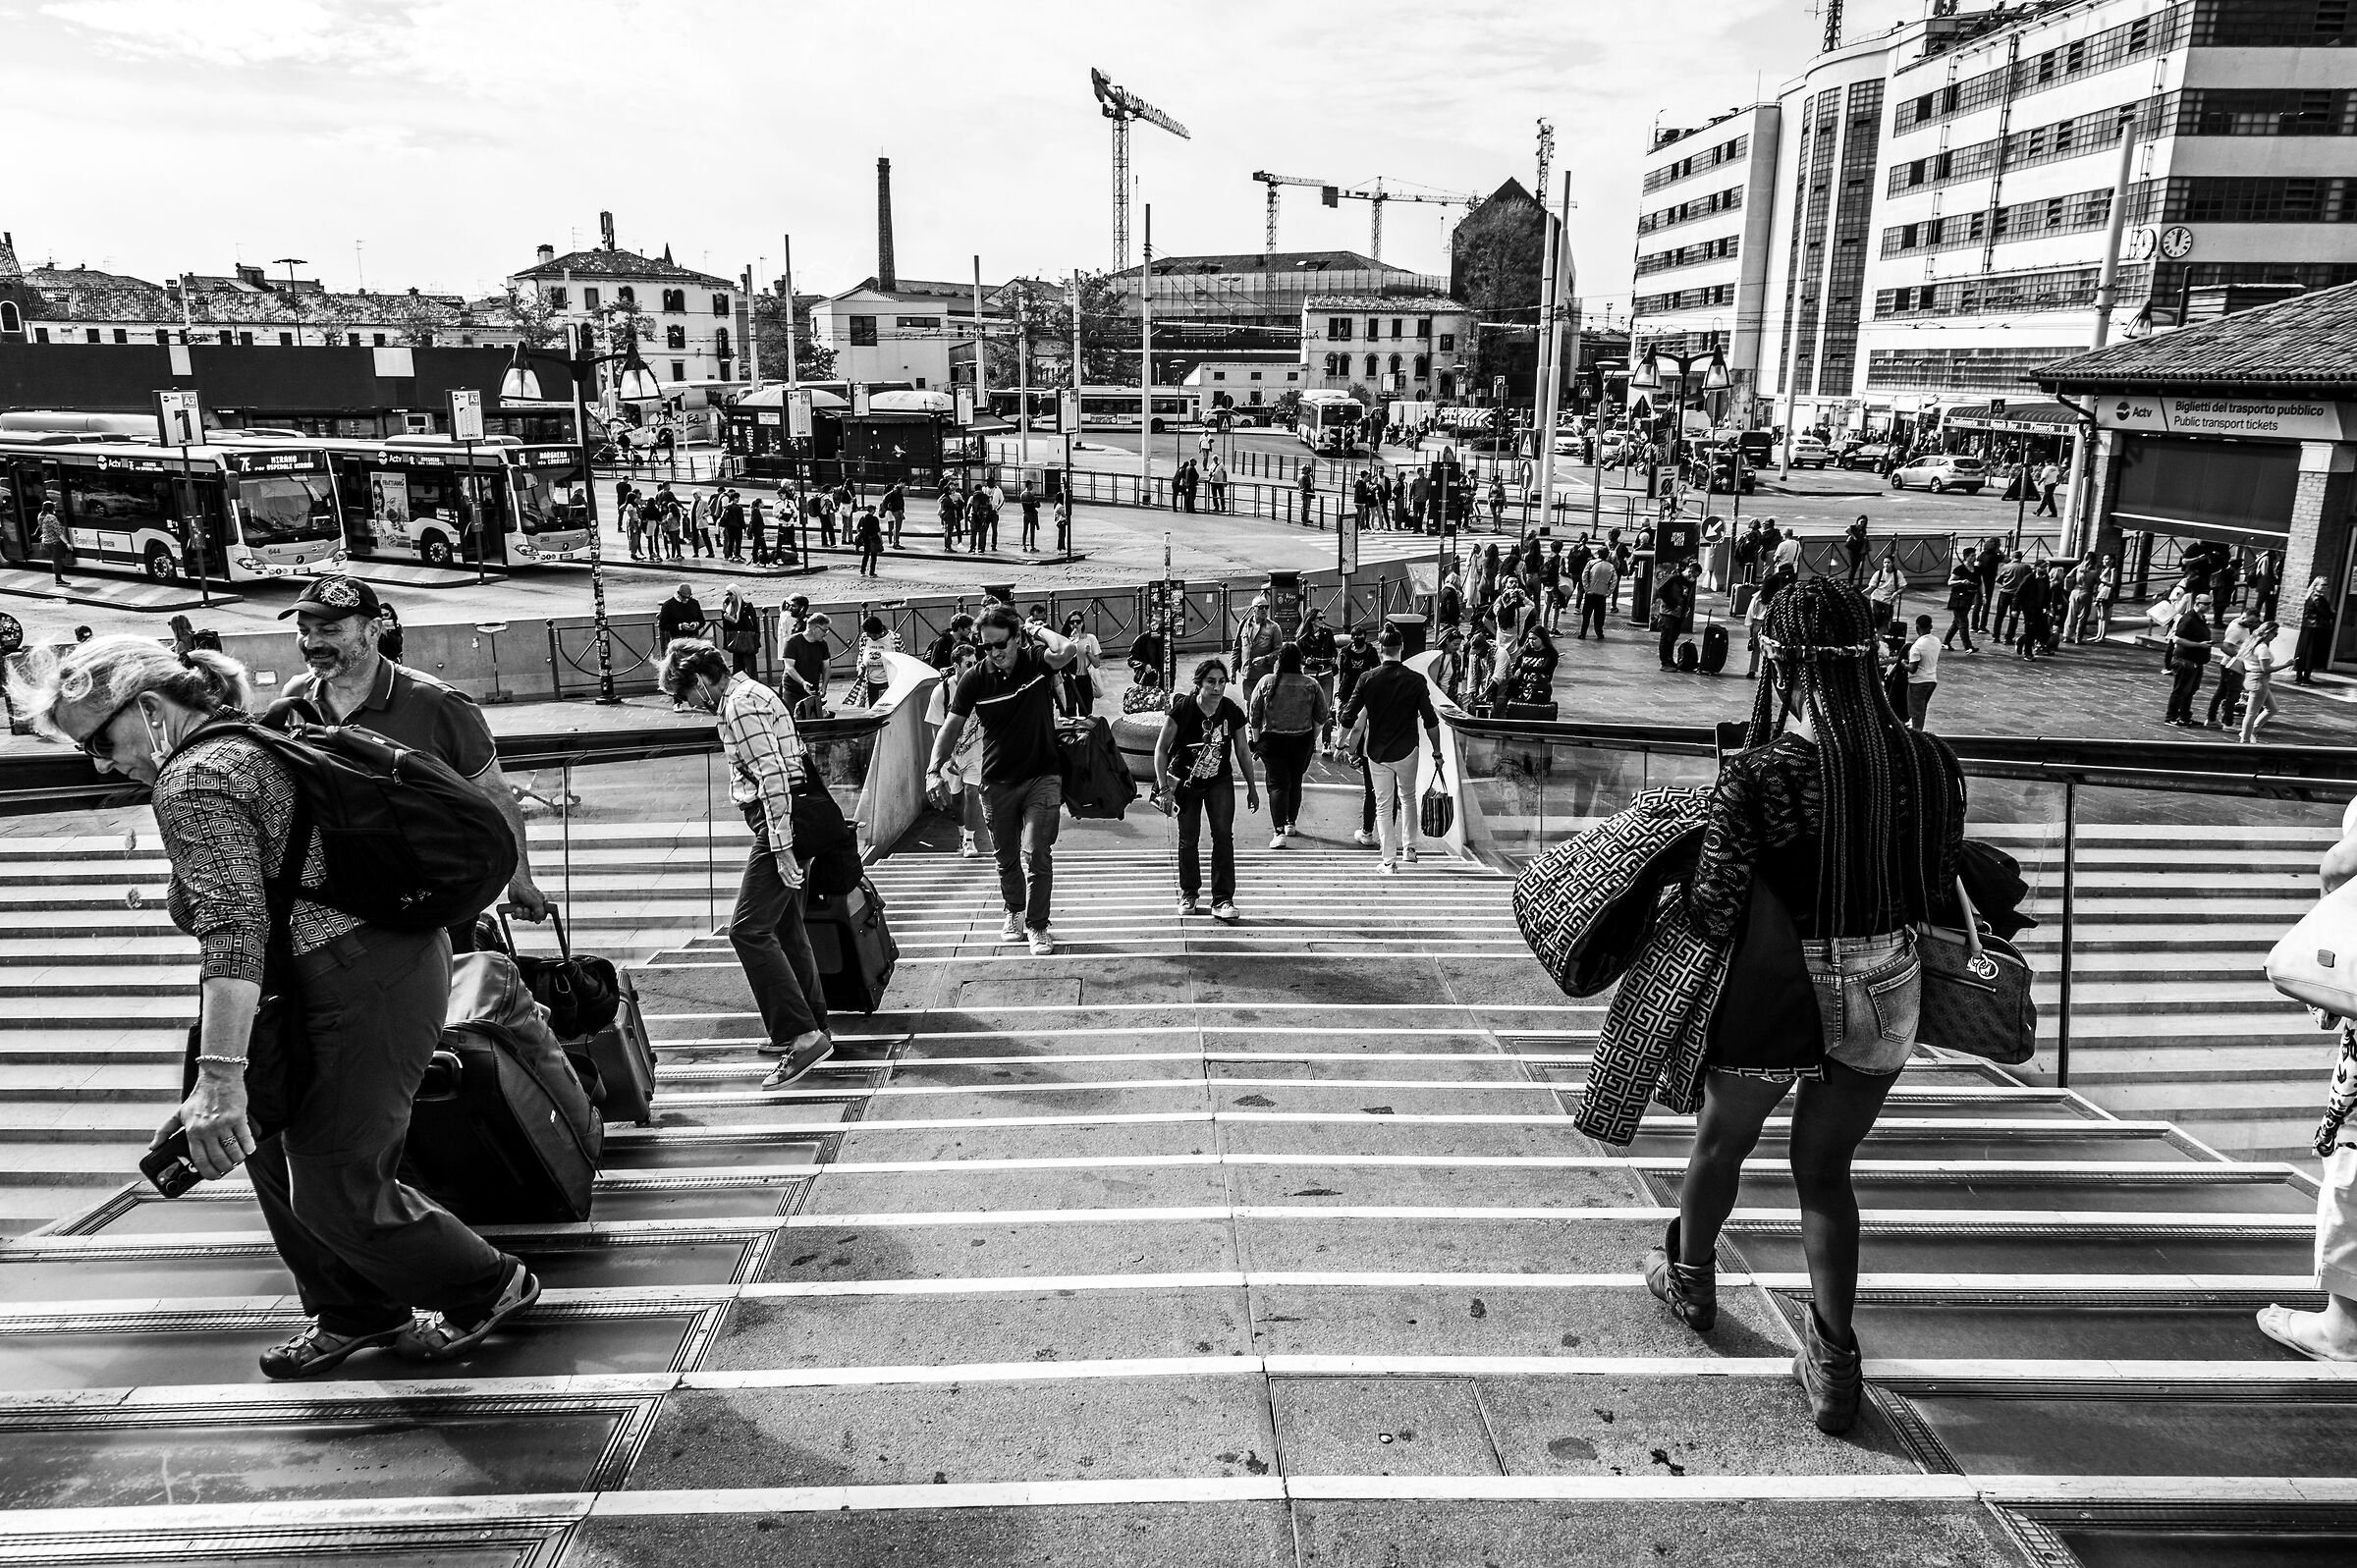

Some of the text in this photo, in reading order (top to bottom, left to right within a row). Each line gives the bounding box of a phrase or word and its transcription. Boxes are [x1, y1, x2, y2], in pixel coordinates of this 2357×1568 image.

[184, 397, 195, 406] A2
[2132, 406, 2154, 418] Actv
[2175, 401, 2325, 417] Biglietti del trasporto pubblico
[2173, 415, 2278, 431] Public transport tickets
[239, 457, 251, 472] 7E
[270, 455, 298, 464] MIRANO
